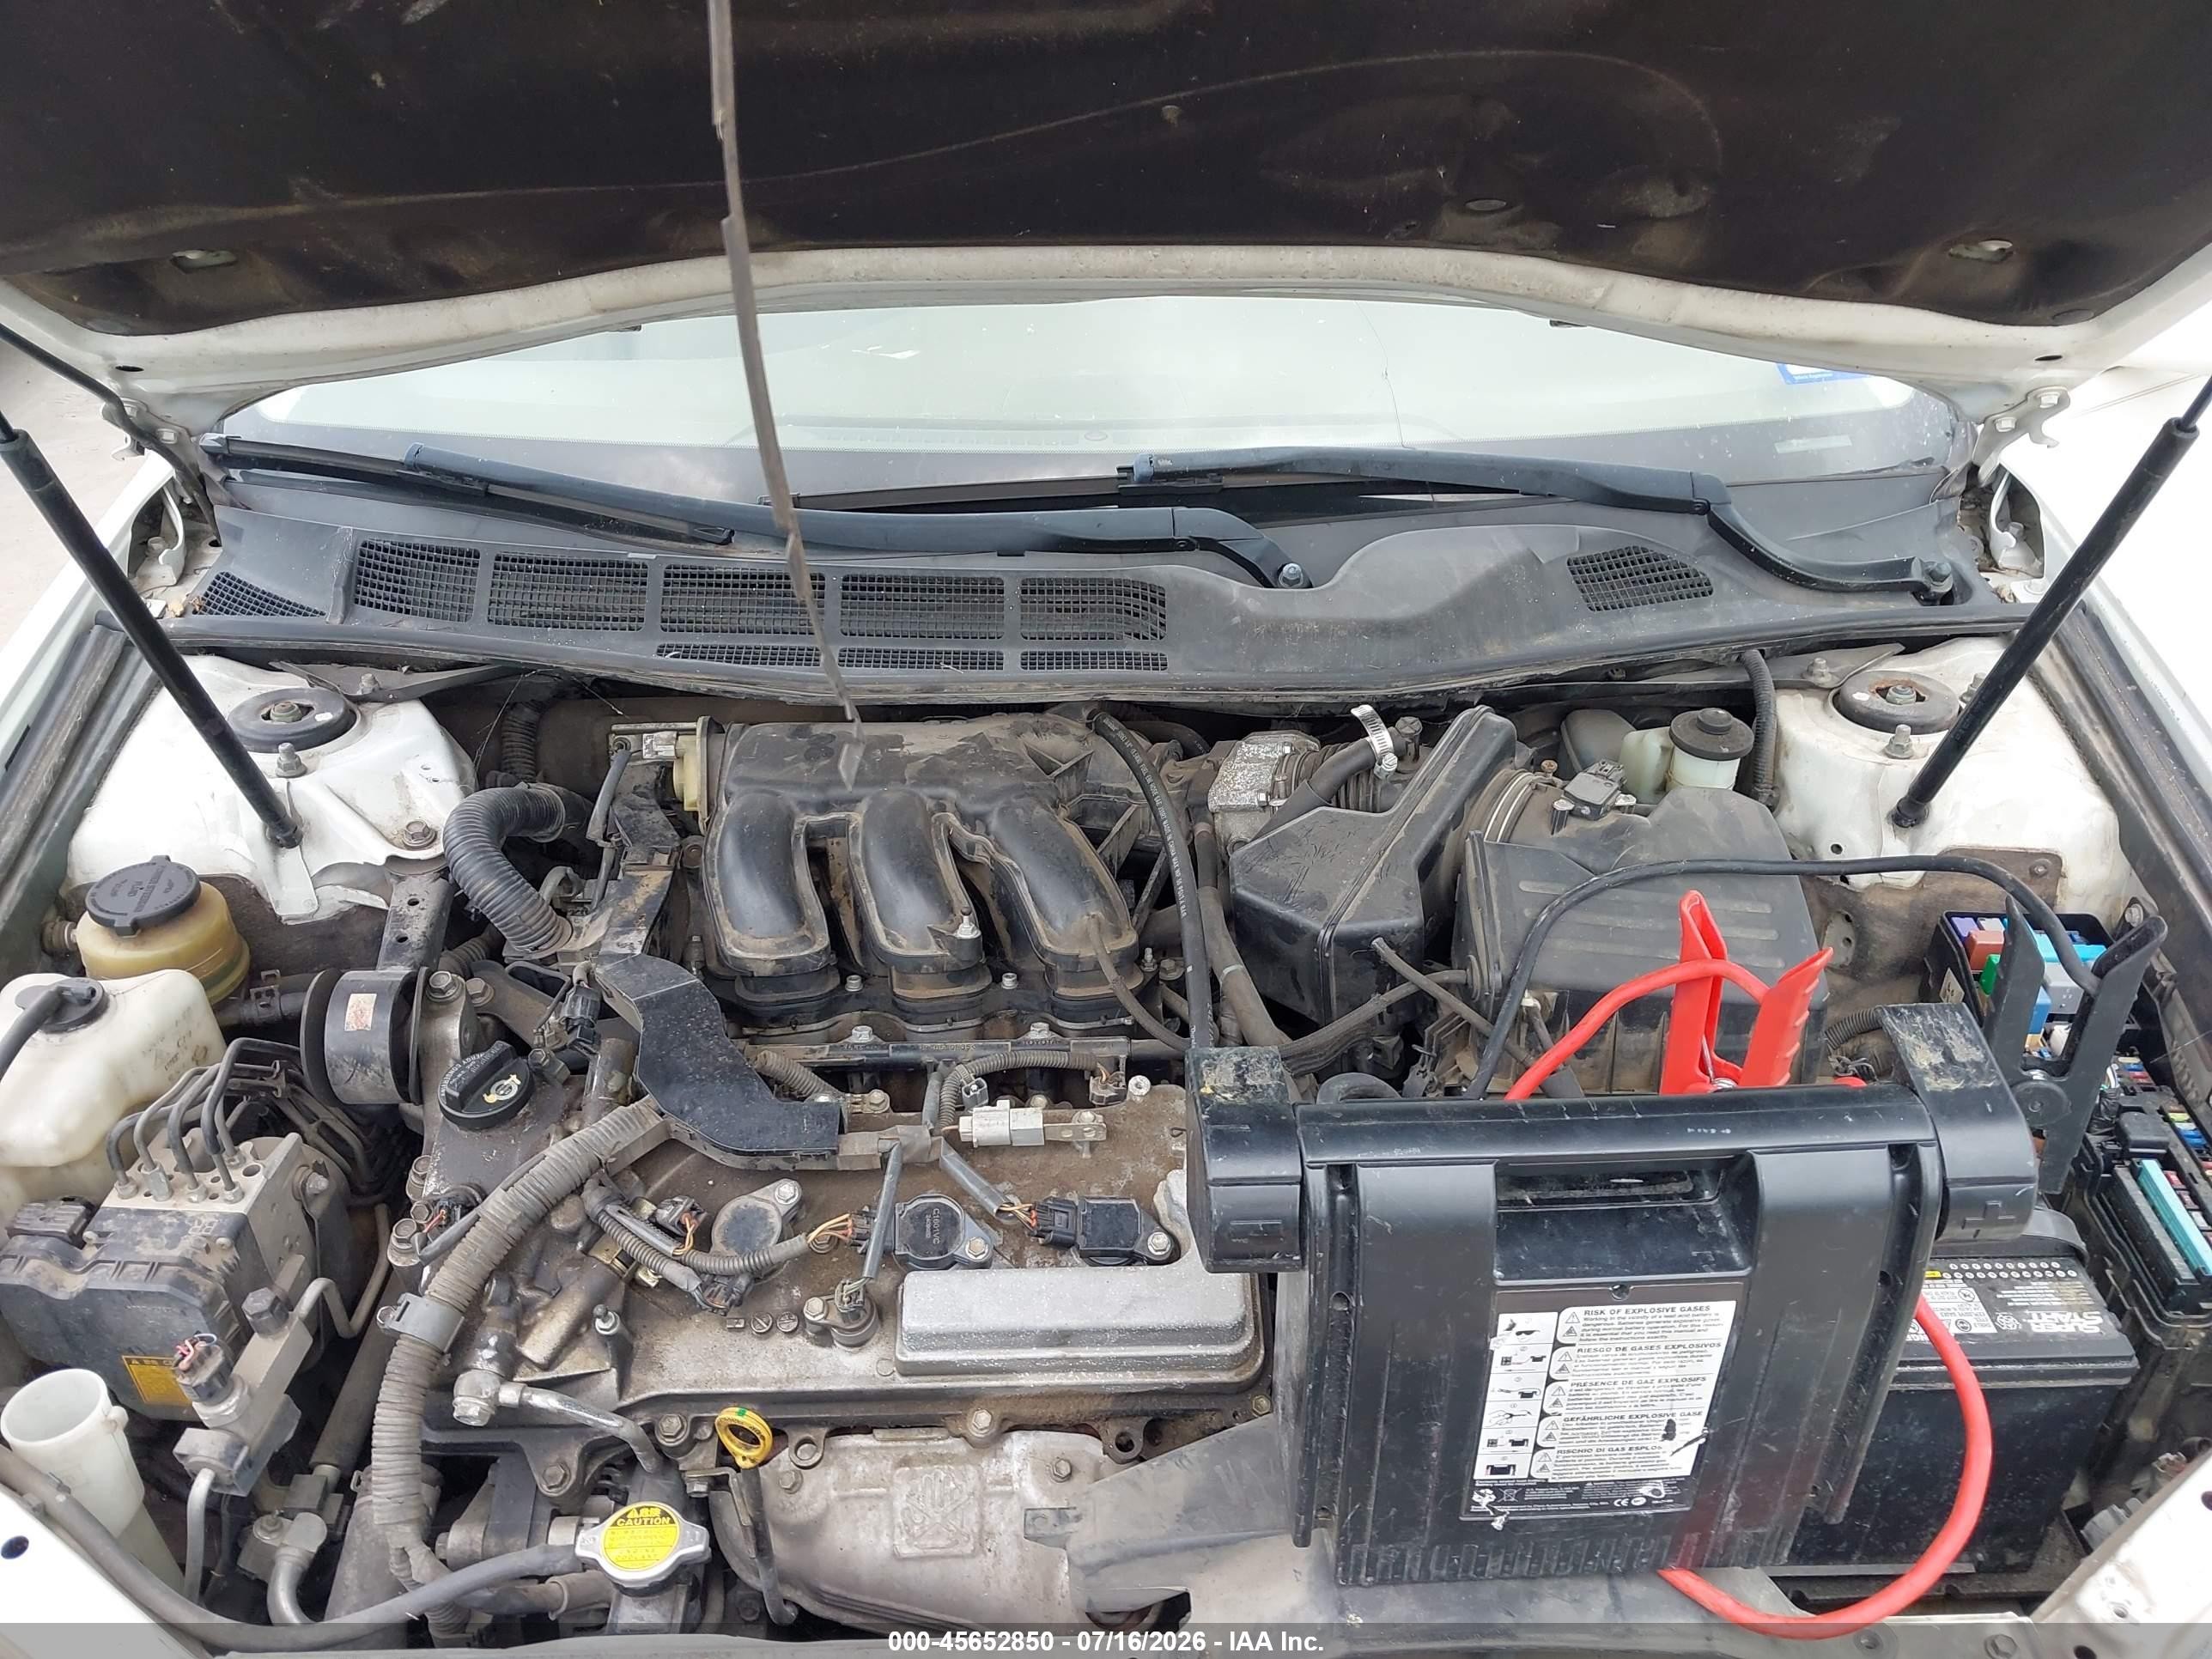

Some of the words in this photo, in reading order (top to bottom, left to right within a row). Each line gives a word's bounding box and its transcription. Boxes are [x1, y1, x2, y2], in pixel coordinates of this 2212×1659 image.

[1625, 1306, 1677, 1315] EXPLOSIVE
[2027, 1310, 2105, 1325] START
[2031, 1322, 2101, 1334] SUPER
[1664, 1342, 1722, 1351] EXPLOSIVOS
[1563, 1413, 1626, 1422] GEFÄHRLICHE
[617, 1516, 671, 1527] CAUTION
